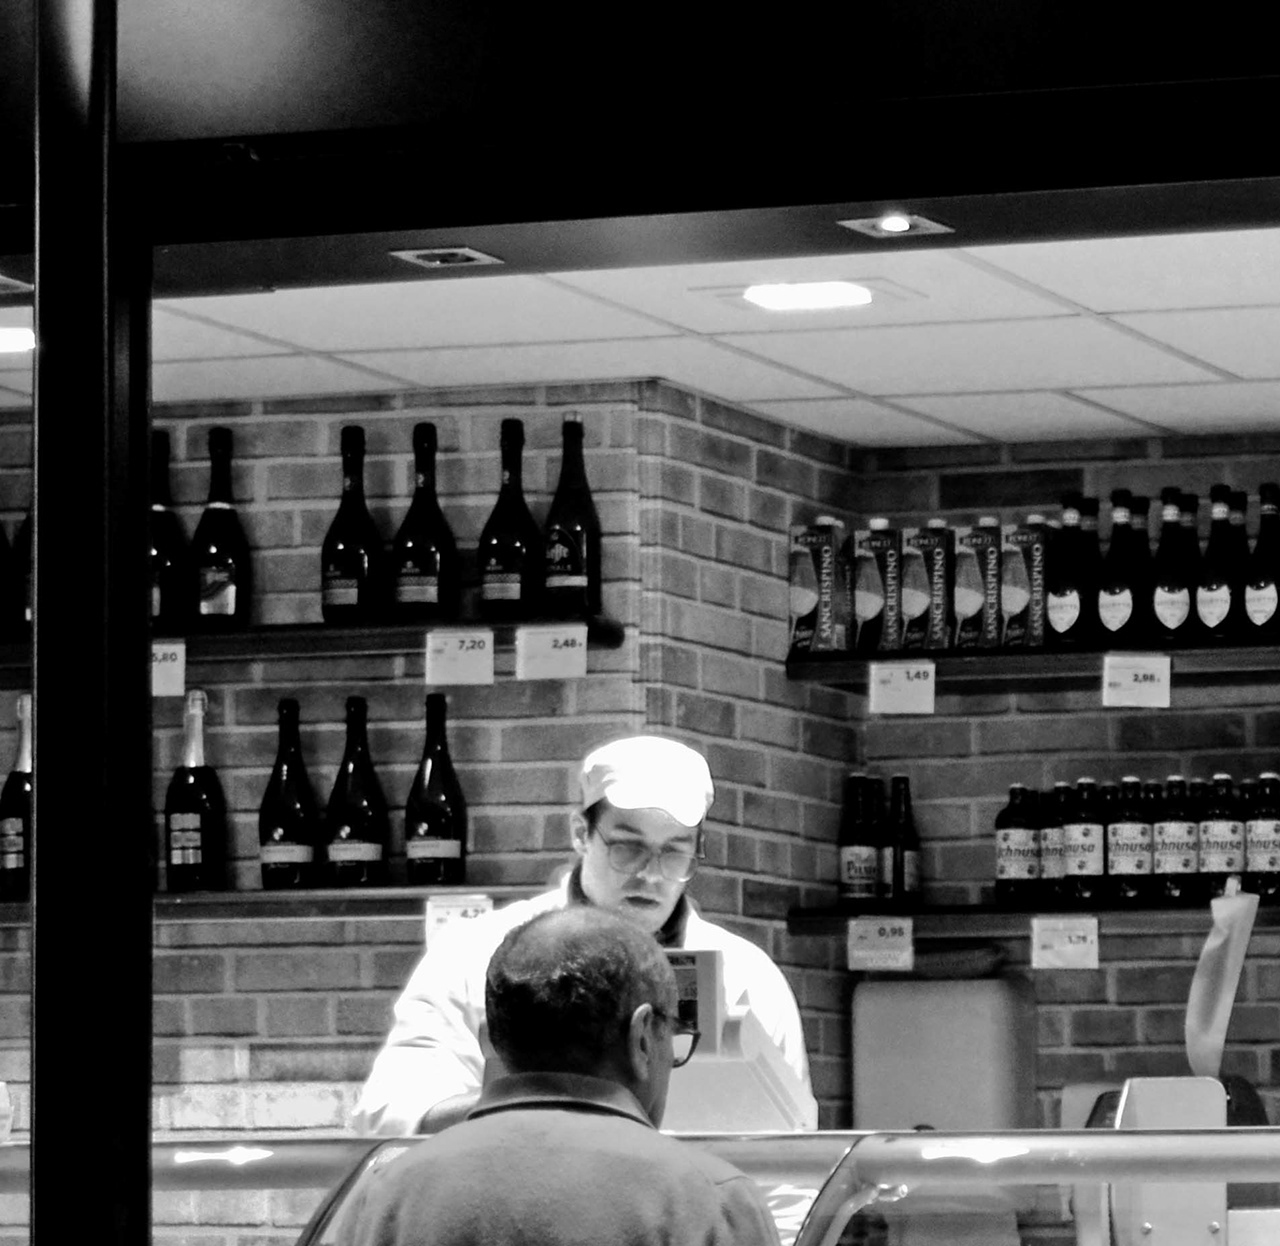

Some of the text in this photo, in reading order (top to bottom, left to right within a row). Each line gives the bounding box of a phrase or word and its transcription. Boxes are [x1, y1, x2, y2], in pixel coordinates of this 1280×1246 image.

[820, 546, 833, 638] SANCRISPINO
[886, 549, 898, 641] SANCRISPINO
[932, 548, 945, 640] SANCRISPINO
[986, 547, 998, 639] SANCRISPINO
[1032, 543, 1043, 636] SANCRISPINO
[458, 639, 486, 651] 7,20
[905, 670, 930, 682] 1,49
